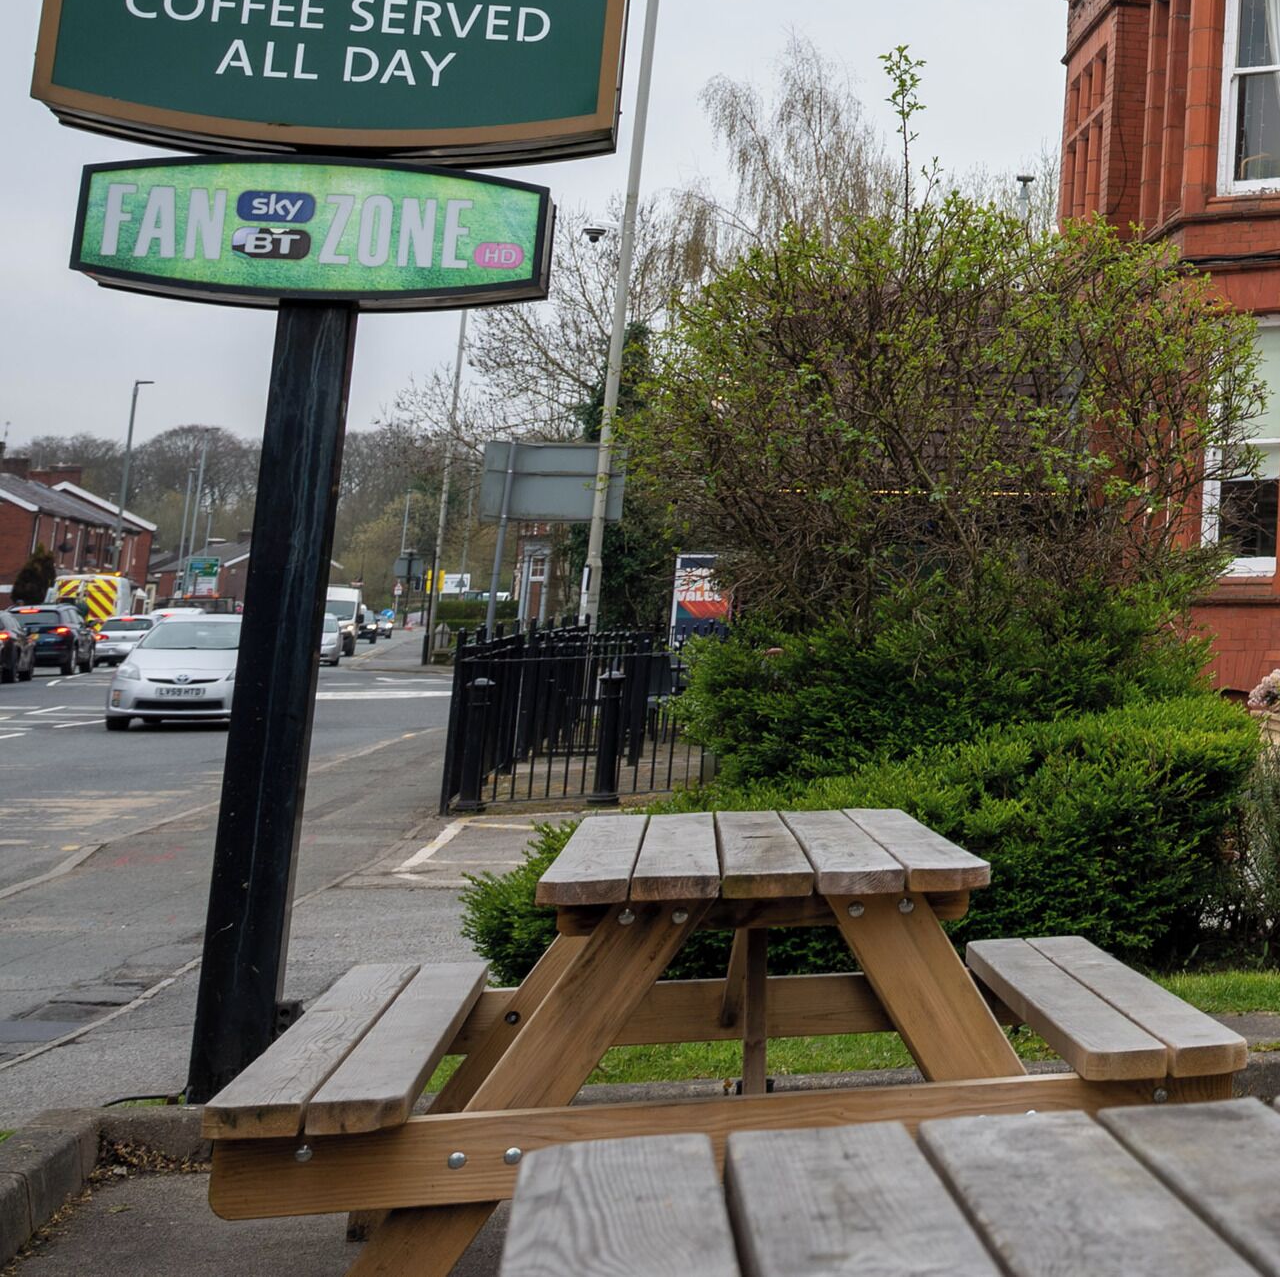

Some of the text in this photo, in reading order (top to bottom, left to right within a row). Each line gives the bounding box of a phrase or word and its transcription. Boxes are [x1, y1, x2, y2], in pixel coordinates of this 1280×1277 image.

[215, 39, 457, 87] ALL DAY
[250, 194, 304, 222] sky
[101, 182, 475, 272] FAN ZONE
[244, 229, 301, 255] BT
[484, 246, 517, 265] HD
